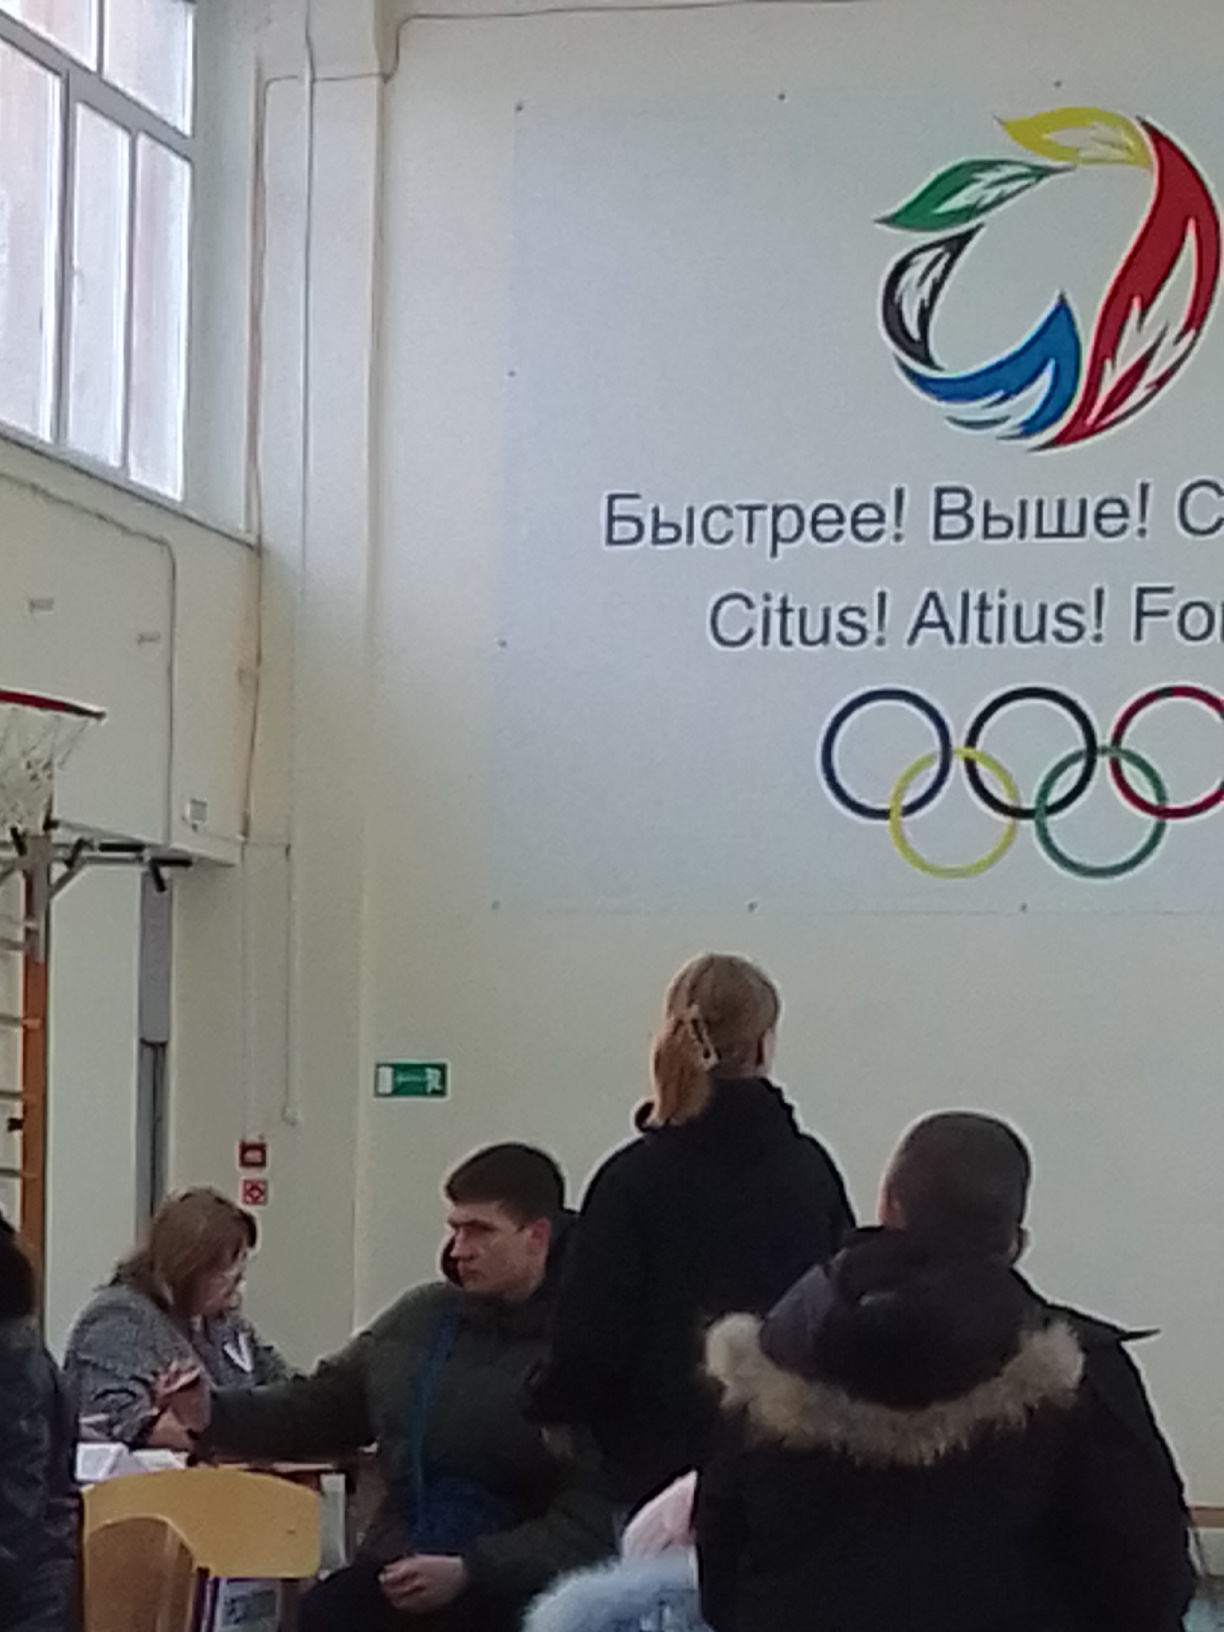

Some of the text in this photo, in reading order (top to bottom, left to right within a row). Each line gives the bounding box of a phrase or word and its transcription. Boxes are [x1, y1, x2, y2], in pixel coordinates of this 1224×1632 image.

[603, 486, 906, 558] Быстрее!
[932, 481, 1151, 542] Выше!
[709, 585, 1224, 647] Citus! Altius! Fo
